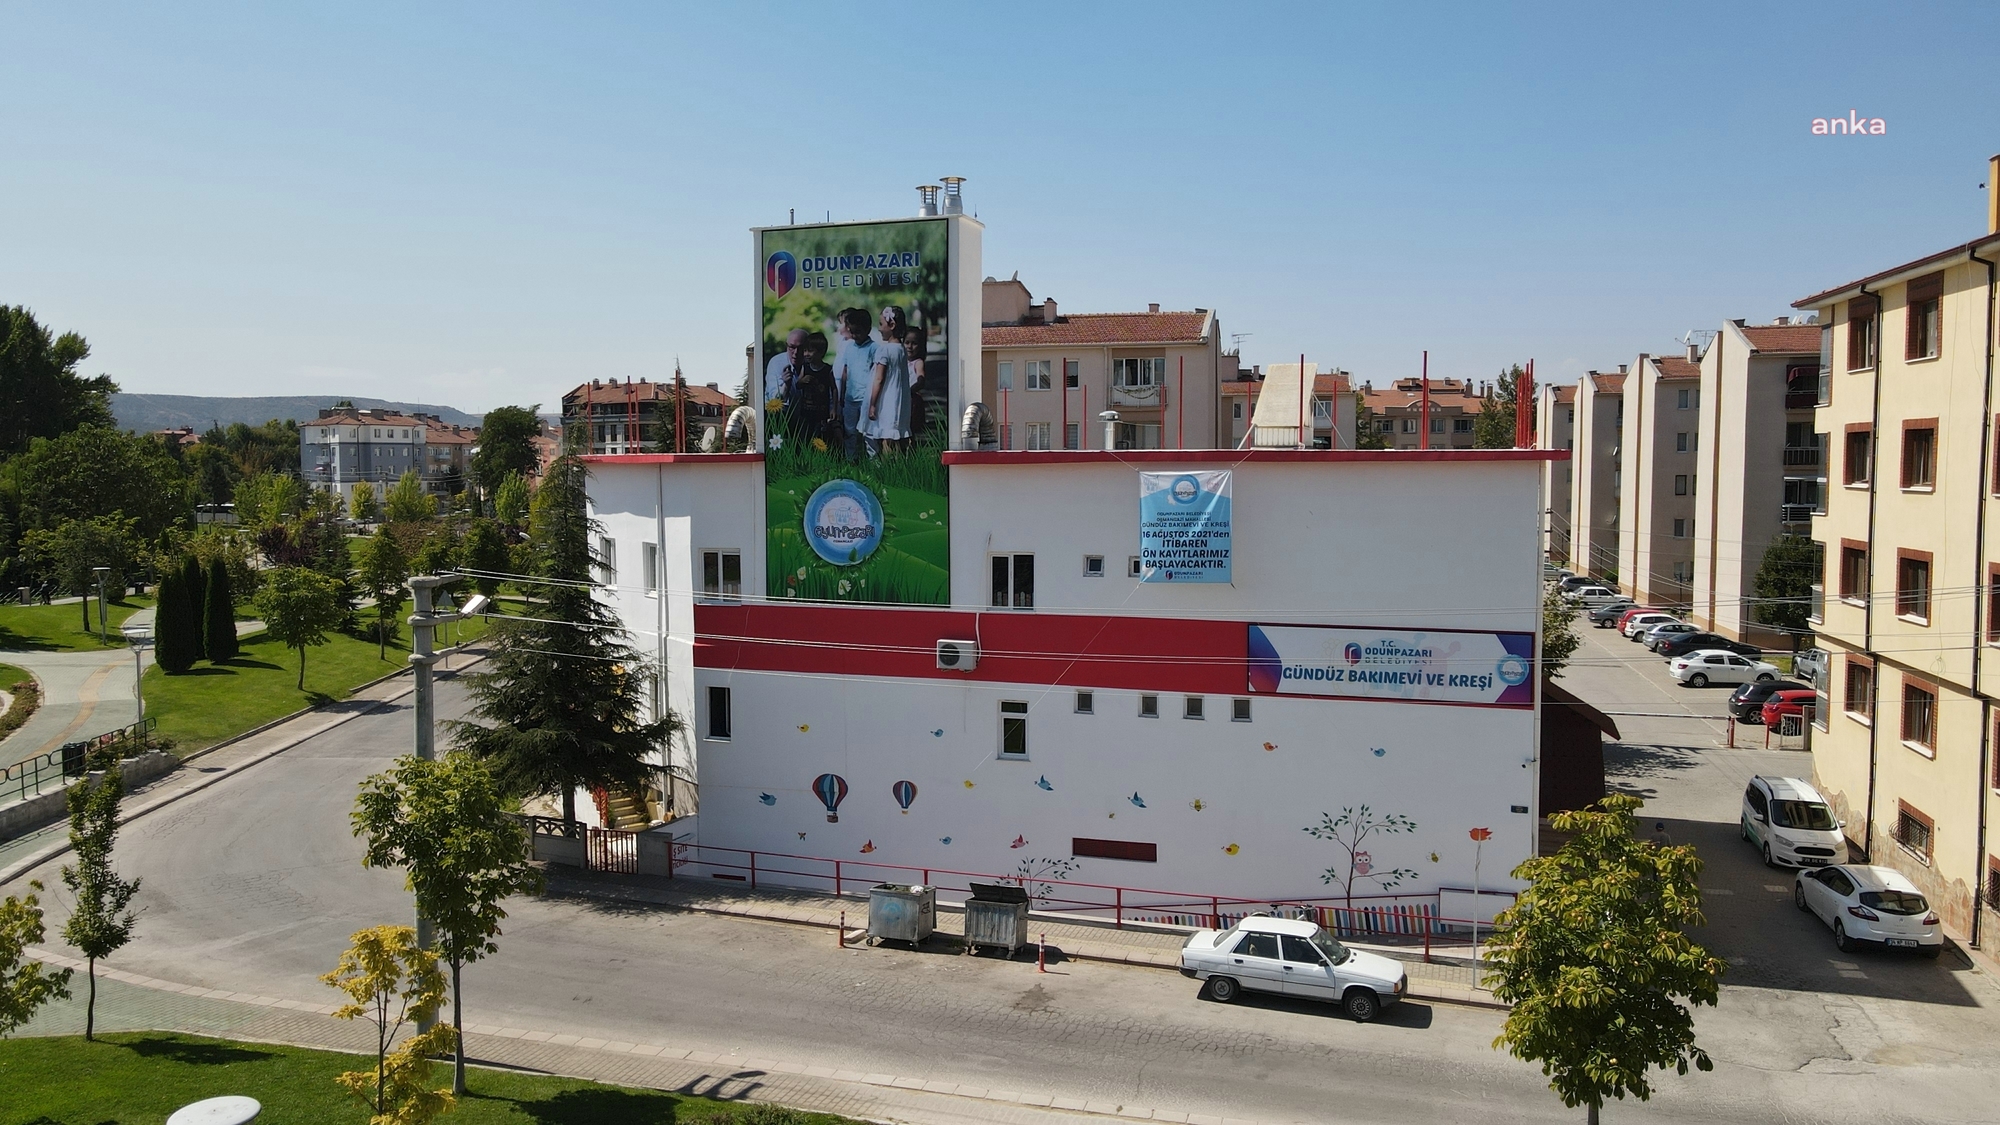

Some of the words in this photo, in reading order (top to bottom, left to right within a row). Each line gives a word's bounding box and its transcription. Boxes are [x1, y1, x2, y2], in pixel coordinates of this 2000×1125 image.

[802, 252, 920, 272] ODUNPAZARI
[803, 273, 920, 289] BELEDİYESİ
[1152, 529, 1189, 538] AĞUSTOS
[1191, 530, 1229, 538] 2021'den
[1162, 537, 1208, 548] İTİBAREN
[1143, 548, 1157, 558] ÖN
[1159, 549, 1229, 558] KAYITLARIMIZ
[1145, 559, 1226, 570] BAŞLAYACAKTIR.
[1381, 640, 1396, 648] T.C.
[1364, 647, 1432, 658] ODUNPAZARI
[1283, 664, 1344, 682] GÜNDÜZ
[1348, 669, 1422, 686] BAKIMEVİ
[1426, 673, 1445, 686] VE
[1448, 673, 1493, 691] KREŞİ
